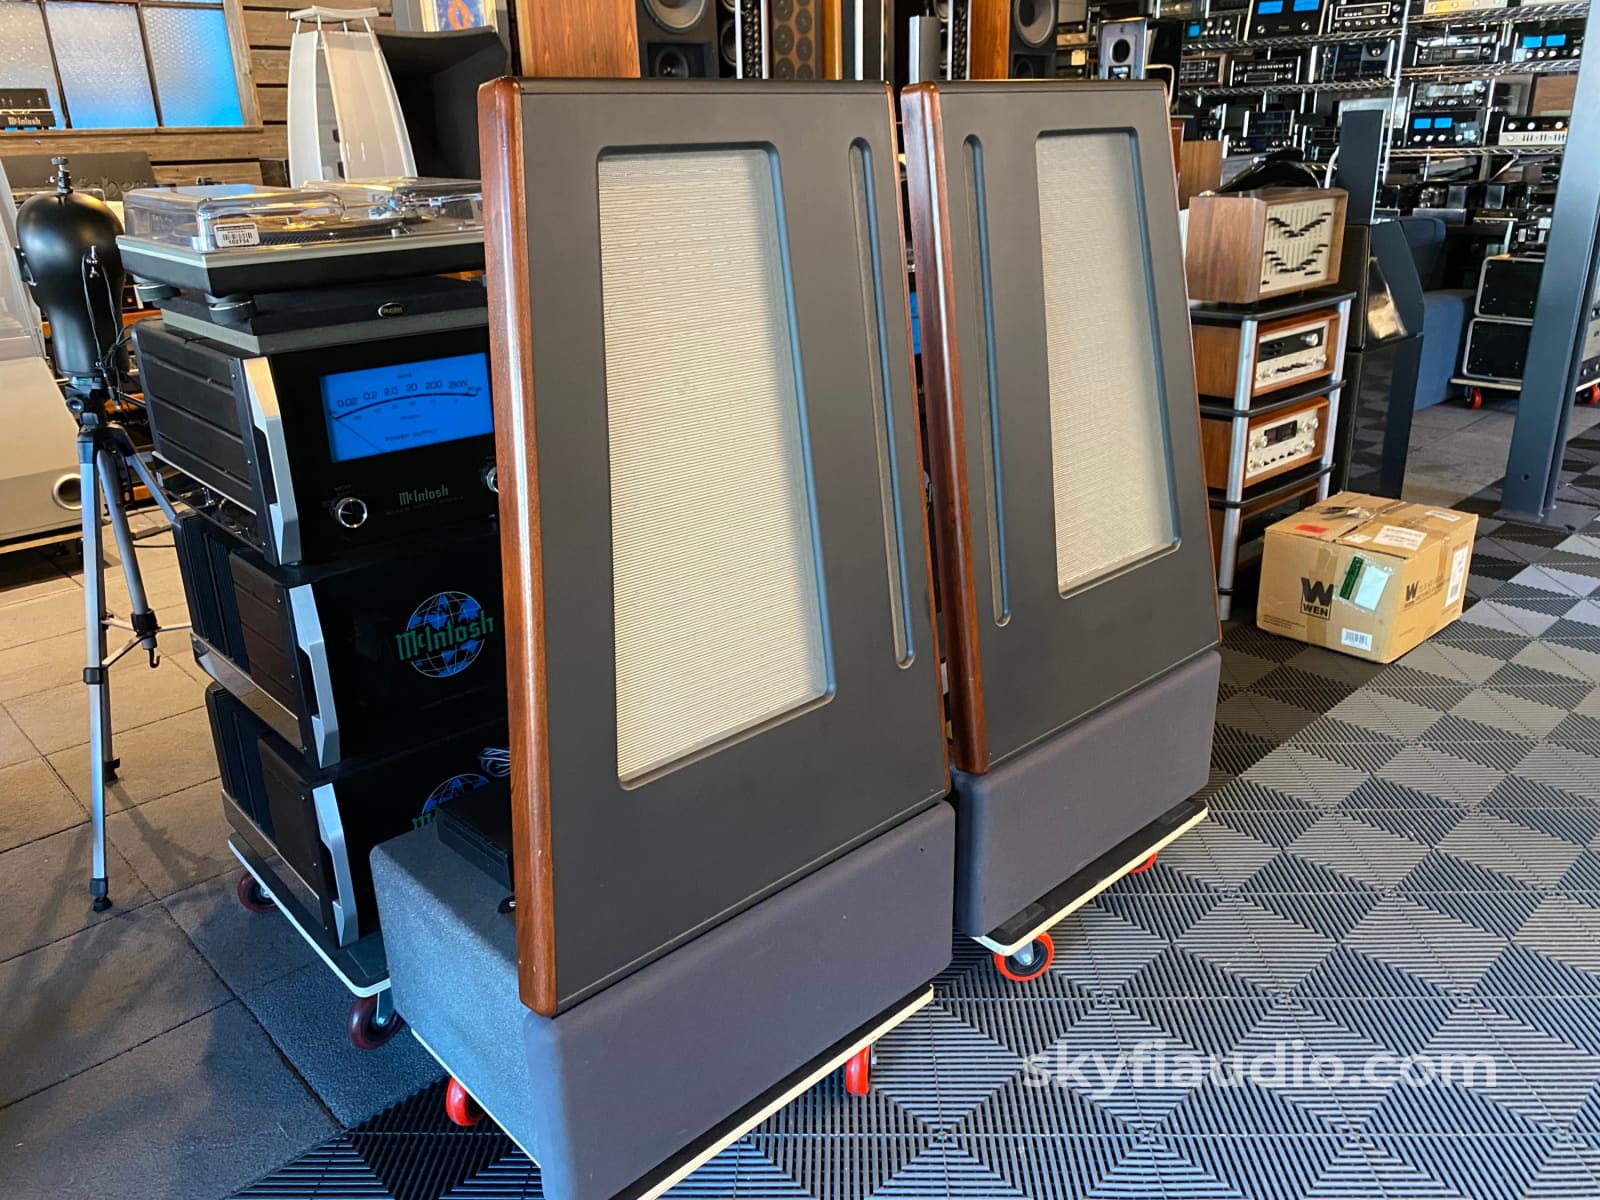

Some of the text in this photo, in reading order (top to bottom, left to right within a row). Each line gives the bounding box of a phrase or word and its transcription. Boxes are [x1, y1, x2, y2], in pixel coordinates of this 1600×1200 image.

[362, 390, 378, 401] 0.2
[383, 386, 399, 396] 2.0
[405, 382, 418, 393] 20
[424, 379, 443, 390] 200
[398, 483, 449, 506] McIntosh
[1303, 603, 1329, 617] WEN
[395, 609, 495, 660] McIntosh
